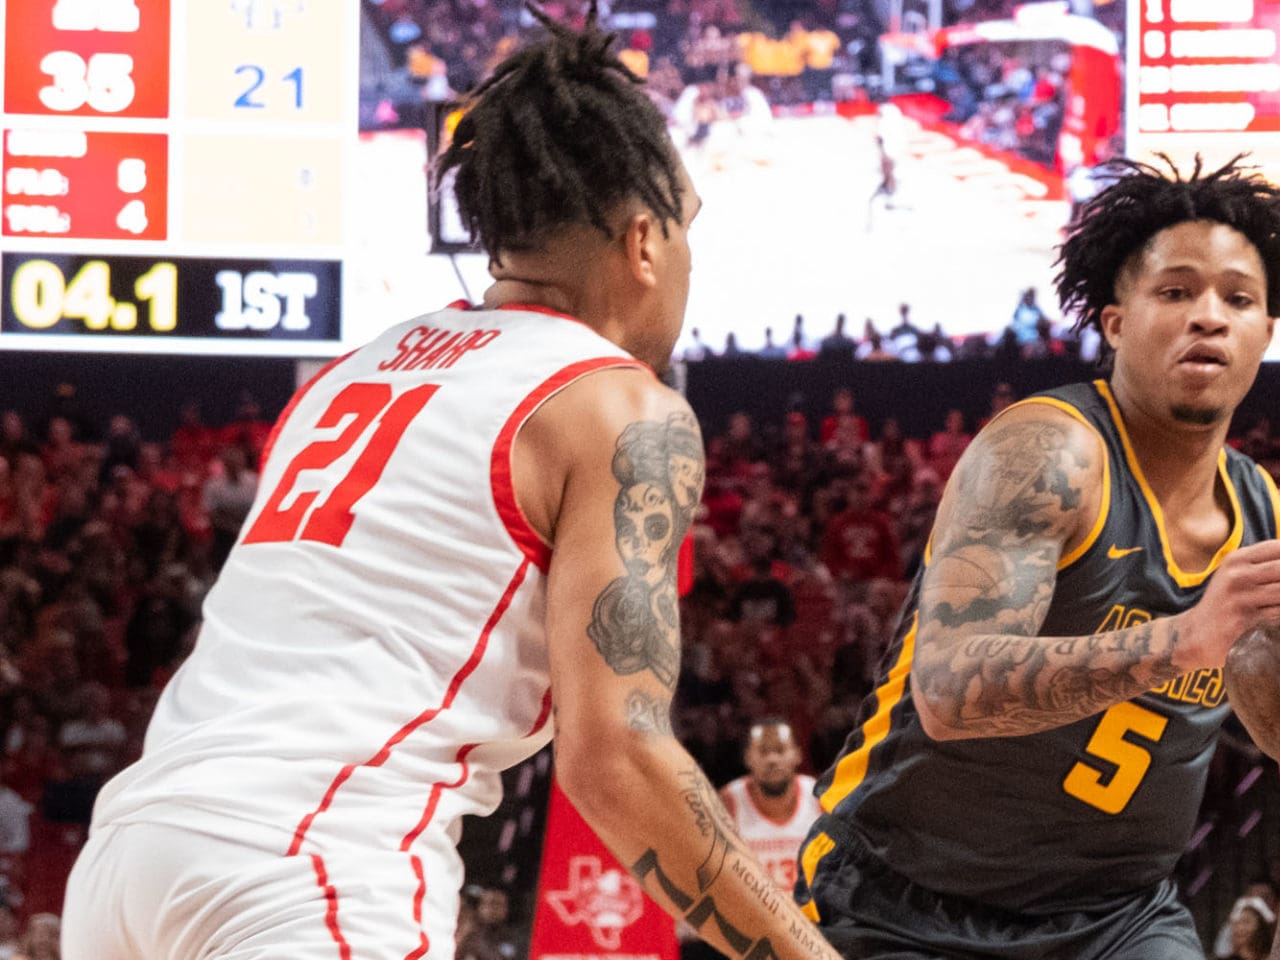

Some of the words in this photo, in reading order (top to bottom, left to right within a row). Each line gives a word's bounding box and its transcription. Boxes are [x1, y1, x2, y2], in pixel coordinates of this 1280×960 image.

[233, 64, 304, 109] 21
[11, 258, 179, 331] 04.1
[214, 270, 319, 331] 1ST
[377, 325, 502, 372] SHARP
[240, 382, 443, 548] 21
[1063, 701, 1169, 815] 5
